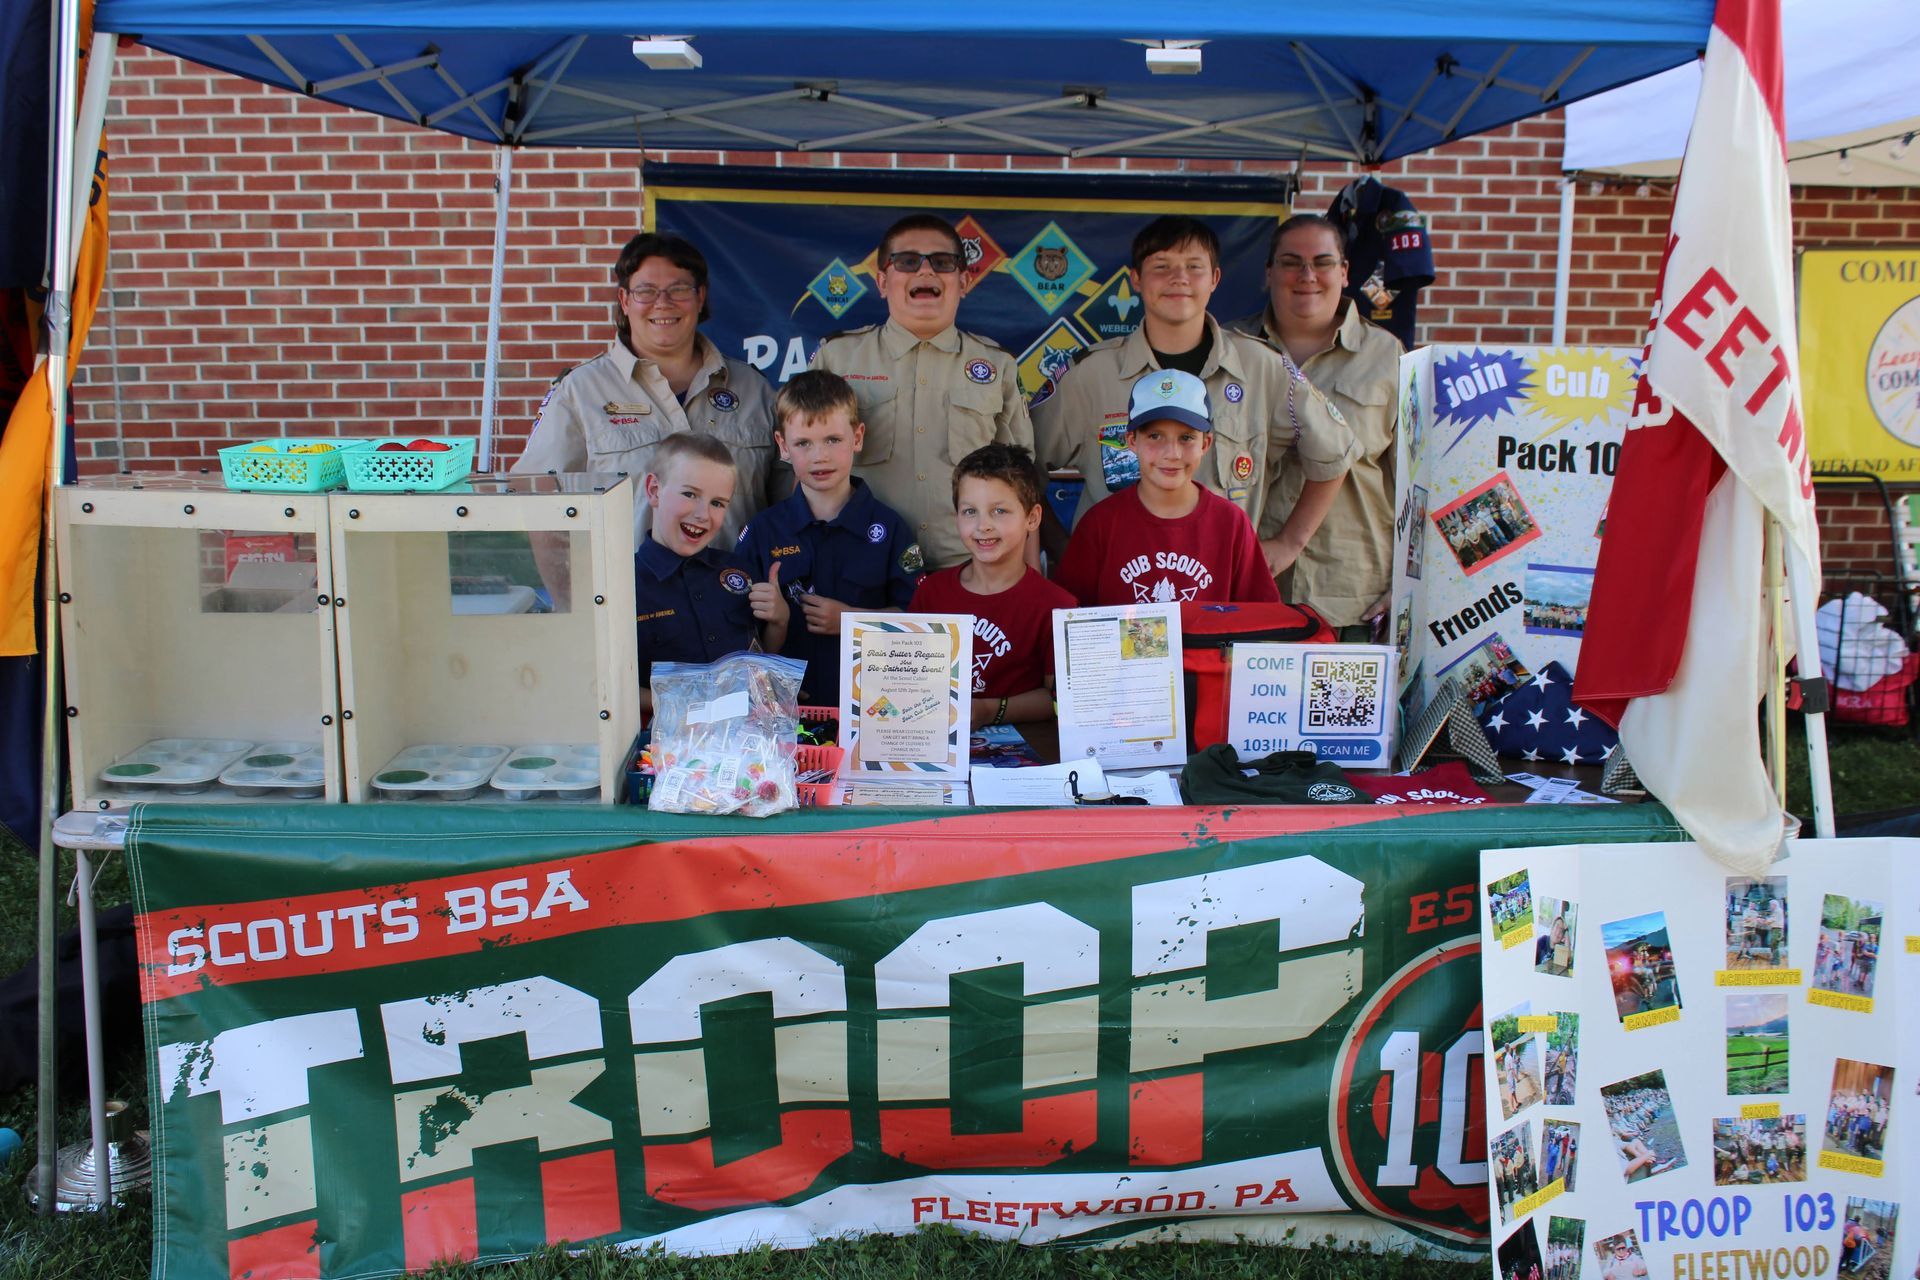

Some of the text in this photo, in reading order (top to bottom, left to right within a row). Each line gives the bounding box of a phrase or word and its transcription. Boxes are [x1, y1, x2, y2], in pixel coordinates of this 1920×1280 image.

[1391, 233, 1420, 250] 103
[1839, 259, 1920, 284] COMI
[1037, 282, 1065, 291] BEAR
[1100, 324, 1139, 333] WEBELO
[743, 335, 808, 382] PA
[1546, 364, 1611, 399] Cub
[1879, 370, 1920, 391] COM
[621, 417, 640, 425] BSA
[1497, 435, 1623, 477] Pack 10
[782, 545, 801, 555] BSA
[1120, 551, 1213, 590] CUB SCOUTS
[1428, 581, 1524, 648] Friends
[973, 615, 1012, 657] OUTS
[867, 649, 945, 660] Rain Gutter Regatta
[1246, 657, 1295, 670] COME
[867, 664, 945, 674] Re-Gathering Event!
[1250, 684, 1287, 697] JOIN
[1248, 711, 1287, 724] PACK
[1243, 738, 1370, 756] 103!!! SCAN ME
[1407, 881, 1481, 935] ES
[167, 869, 590, 978] SCOUTS BSA
[1719, 971, 1801, 987] ACHIEVEMENTS
[1627, 1007, 1680, 1031] CAMPING
[159, 854, 1366, 1280] TROOP
[1377, 1030, 1489, 1187] 10
[1235, 1179, 1299, 1208] PA
[1635, 1192, 1836, 1243] TROOP 103
[1673, 1244, 1830, 1280] FLEETWOOD
